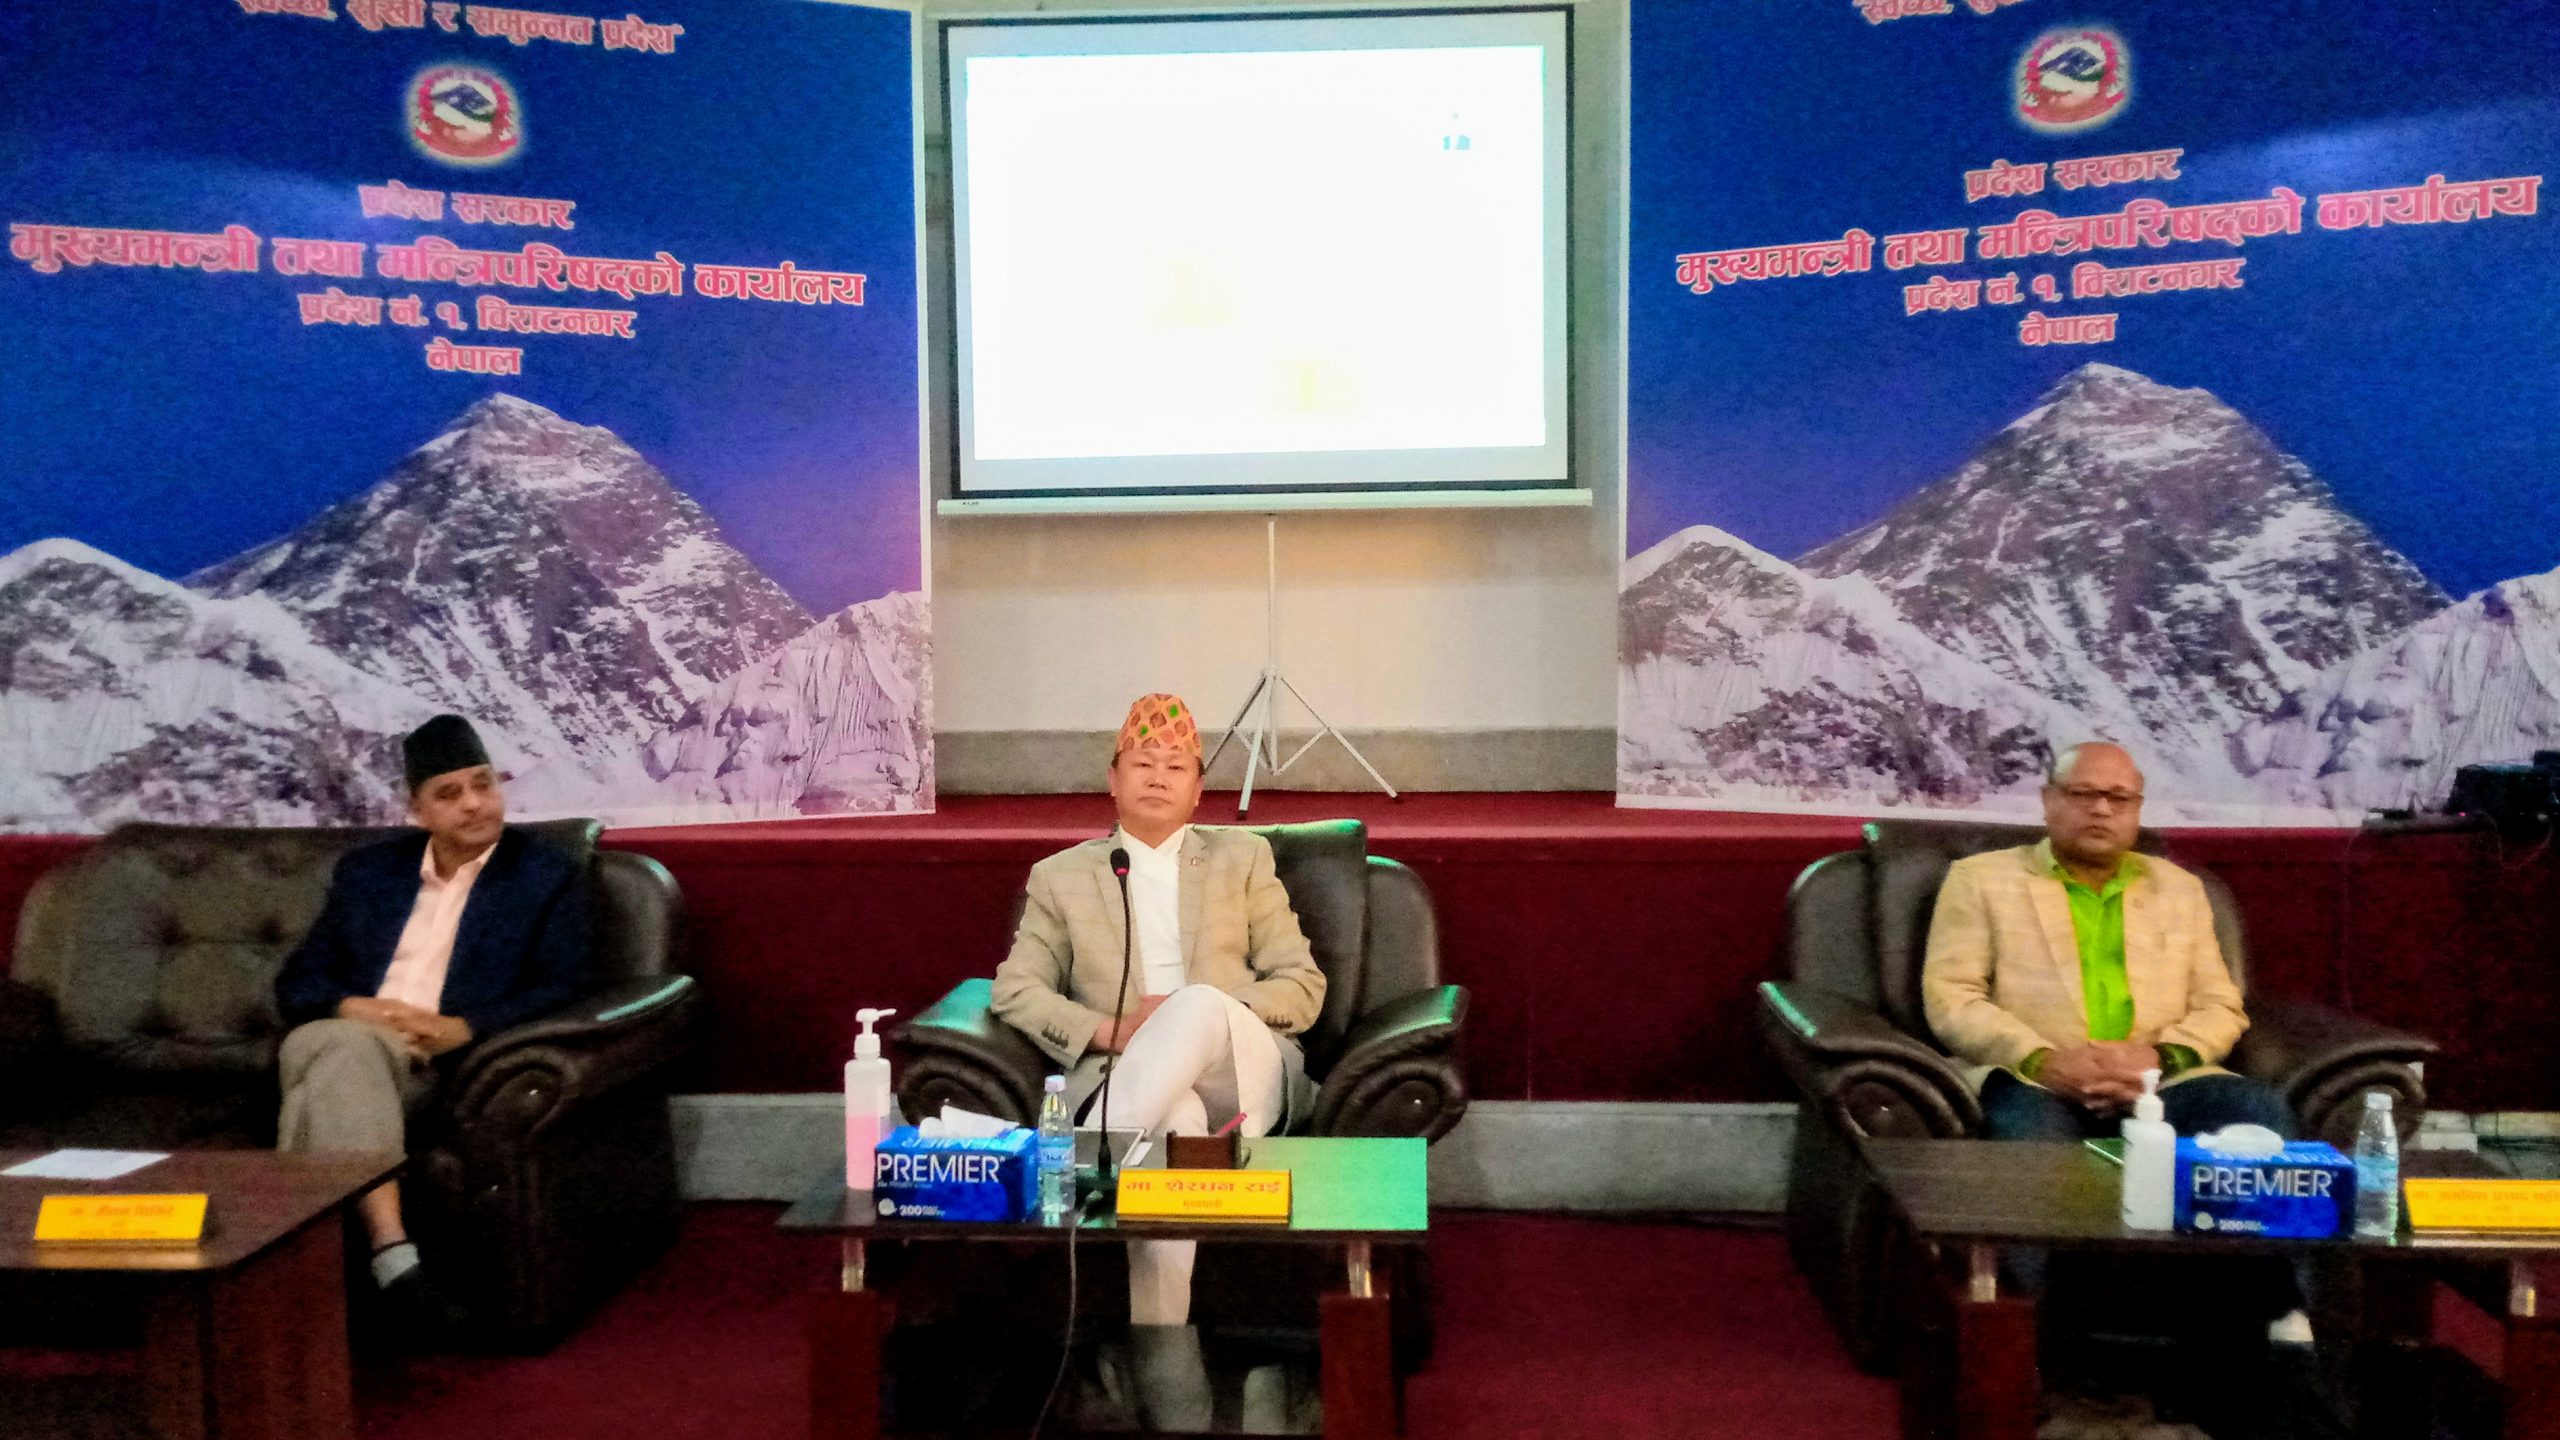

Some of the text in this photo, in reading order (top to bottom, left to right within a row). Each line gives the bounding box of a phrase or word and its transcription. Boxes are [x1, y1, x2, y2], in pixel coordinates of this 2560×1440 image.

[431, 2, 460, 32] र
[465, 5, 596, 46] समुन्नत
[600, 15, 684, 53] प्रदेश
[1965, 148, 2184, 203] प्रदेश सरकार
[359, 180, 576, 230] प्रदेश सरकार
[1676, 228, 1875, 294] मुख्यमन्त्री
[1884, 228, 1969, 271] तथा
[2317, 174, 2542, 230] कार्यालय
[9, 223, 261, 274] मुख्यमन्त्री
[272, 238, 366, 277] तथा
[694, 261, 867, 306] कार्यालय
[1905, 275, 1981, 317] प्रदेश
[1986, 271, 2025, 305] नं.
[2072, 257, 2247, 299] विराटनगर
[299, 287, 384, 327] प्रदेश
[389, 294, 429, 326] नं.
[477, 295, 637, 339] विराटनगर
[2020, 311, 2119, 347] नेपाल
[425, 336, 524, 375] नेपाल
[877, 1153, 1000, 1184] PREMIER
[2194, 1165, 2334, 1198] PREMIER
